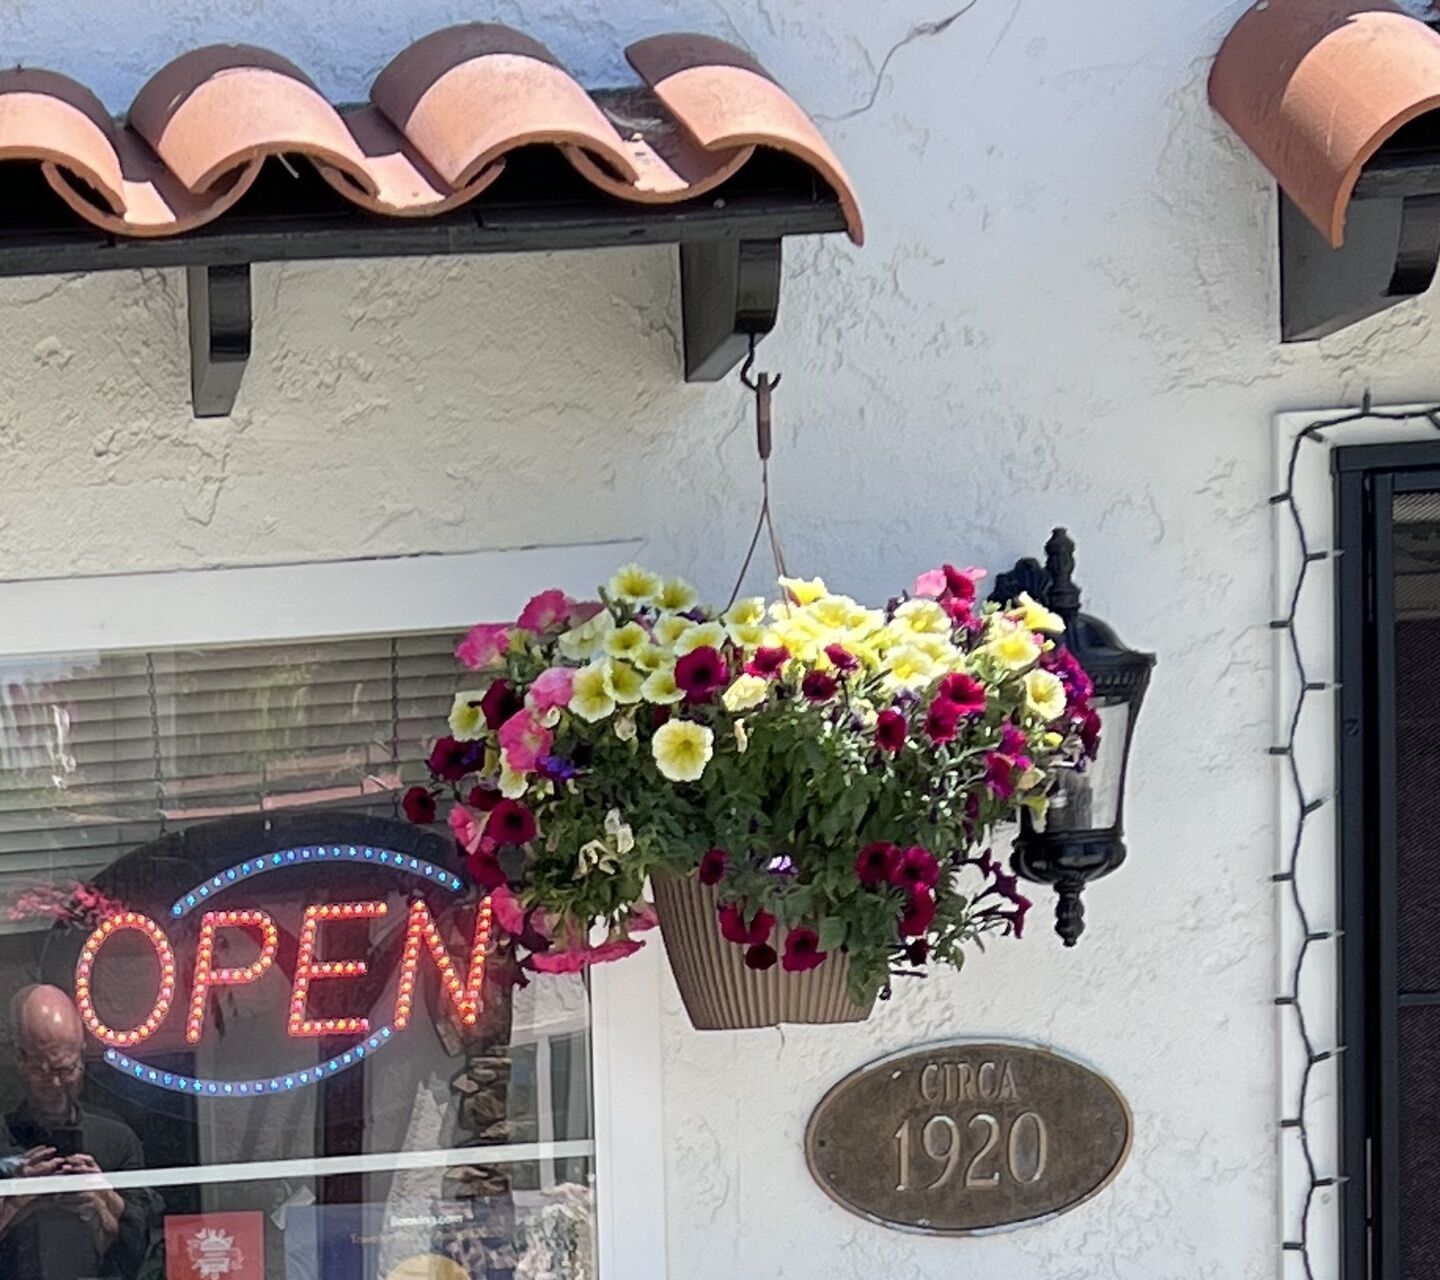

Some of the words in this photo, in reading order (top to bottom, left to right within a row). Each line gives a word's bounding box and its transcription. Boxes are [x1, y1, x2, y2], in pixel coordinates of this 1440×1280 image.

[75, 895, 493, 1047] OPEN
[921, 1062, 1019, 1101] CIRCA
[893, 1111, 1047, 1191] 1920
